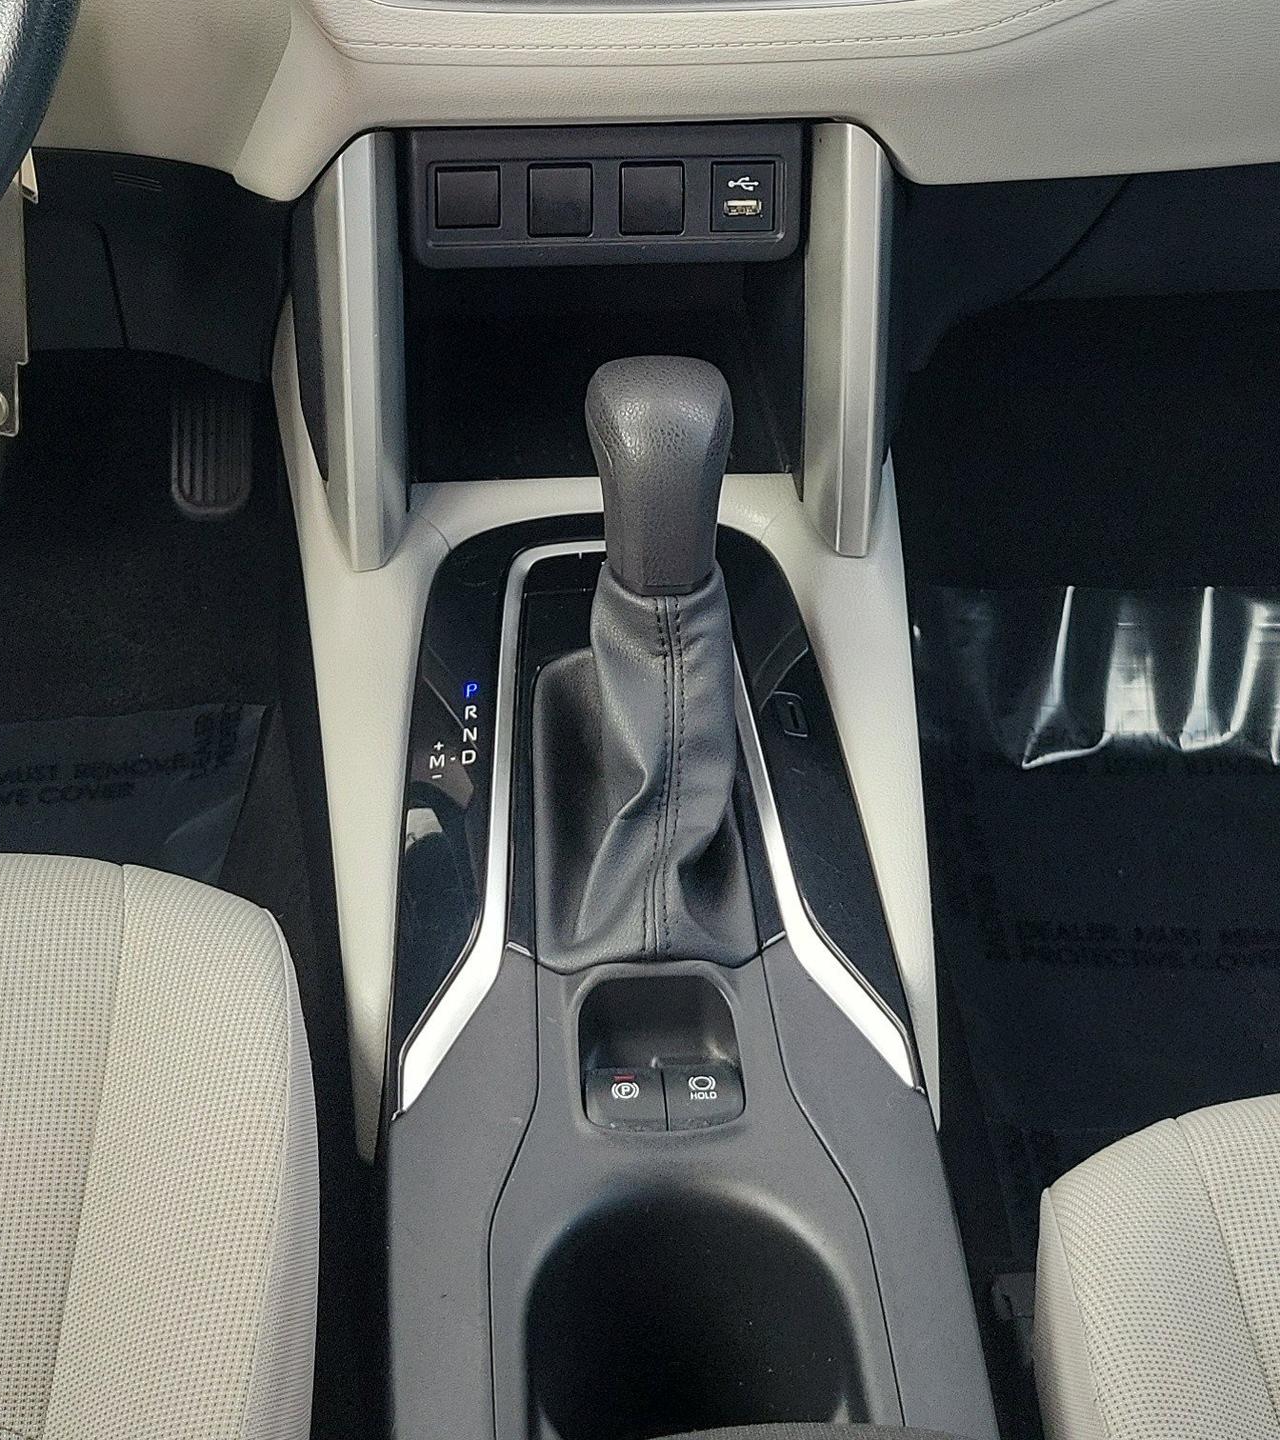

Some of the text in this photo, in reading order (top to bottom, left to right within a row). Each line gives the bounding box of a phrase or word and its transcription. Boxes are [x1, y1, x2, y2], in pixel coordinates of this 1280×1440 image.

[465, 682, 478, 698] P
[464, 705, 478, 720] R
[463, 727, 478, 742] N
[429, 749, 476, 768] M D
[37, 782, 136, 808] COVER
[690, 1091, 718, 1100] HOLD
